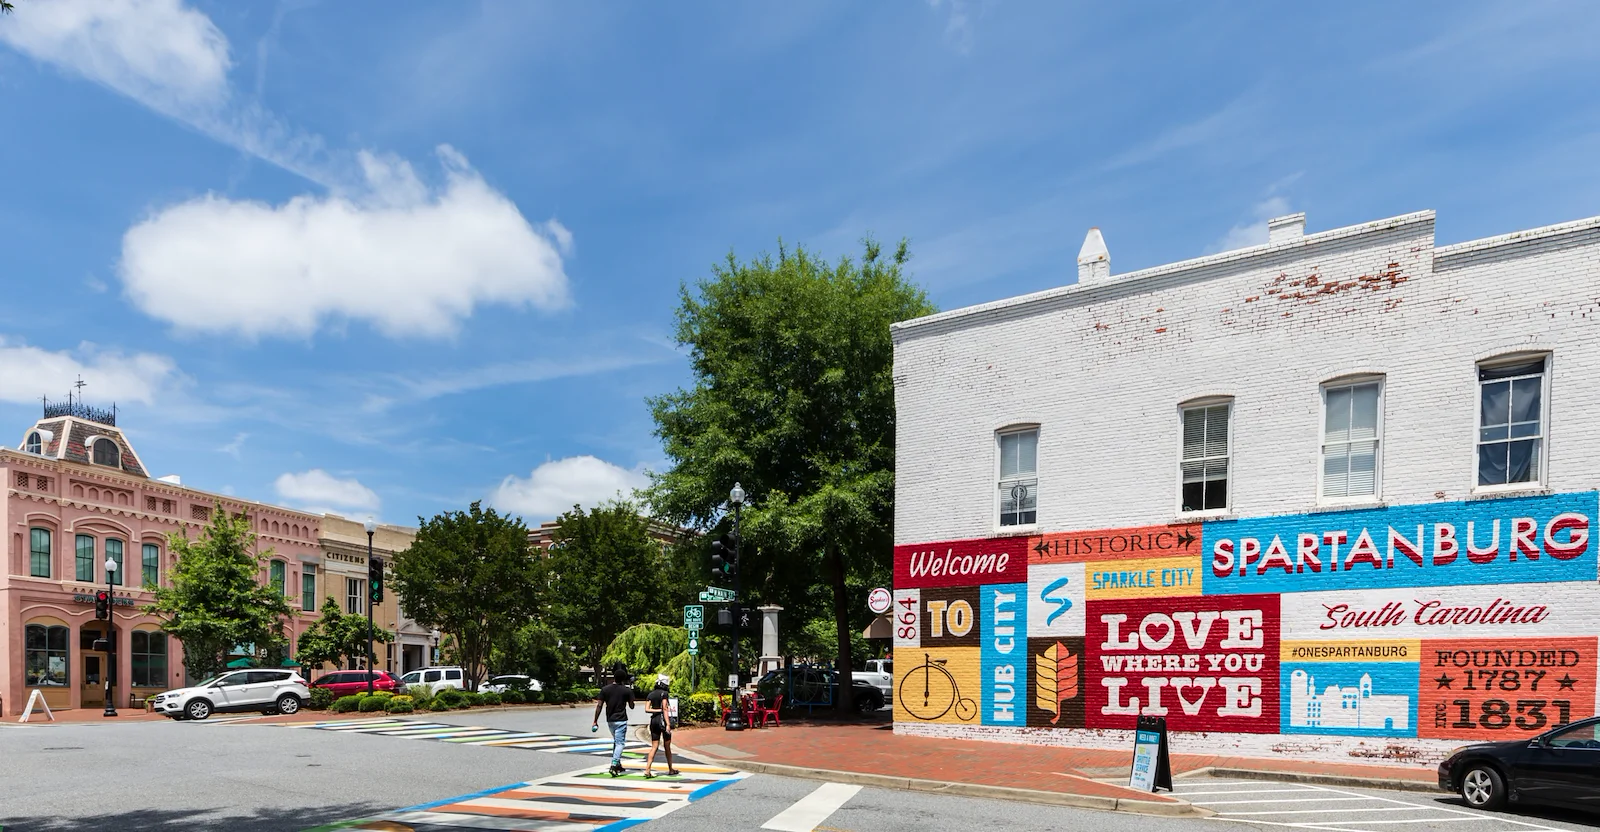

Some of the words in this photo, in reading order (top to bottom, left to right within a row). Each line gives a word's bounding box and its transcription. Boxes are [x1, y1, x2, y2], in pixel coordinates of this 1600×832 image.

[326, 552, 365, 565] CITIZENS
[1052, 531, 1173, 556] HISTORIC
[1212, 512, 1590, 578] SPARTANBURG
[909, 548, 1010, 578] Welcome
[1092, 570, 1156, 590] SPARKLE
[1161, 567, 1195, 588] CITY
[897, 597, 917, 639] 864
[926, 599, 974, 638] TO
[993, 588, 1017, 654] CITY
[1319, 601, 1407, 630] South
[1413, 597, 1550, 626] Carolina
[1100, 609, 1265, 651] LOVE
[1100, 654, 1200, 673] WHERE
[1204, 653, 1265, 673] YOU
[1291, 645, 1408, 658] #ONESPARTANBURG
[1434, 649, 1580, 668] FOUNDED
[993, 664, 1016, 722] HUB
[1462, 669, 1547, 691] 1787
[1101, 676, 1263, 717] LIVE
[1435, 699, 1448, 728] INC.
[1452, 698, 1573, 730] 1831
